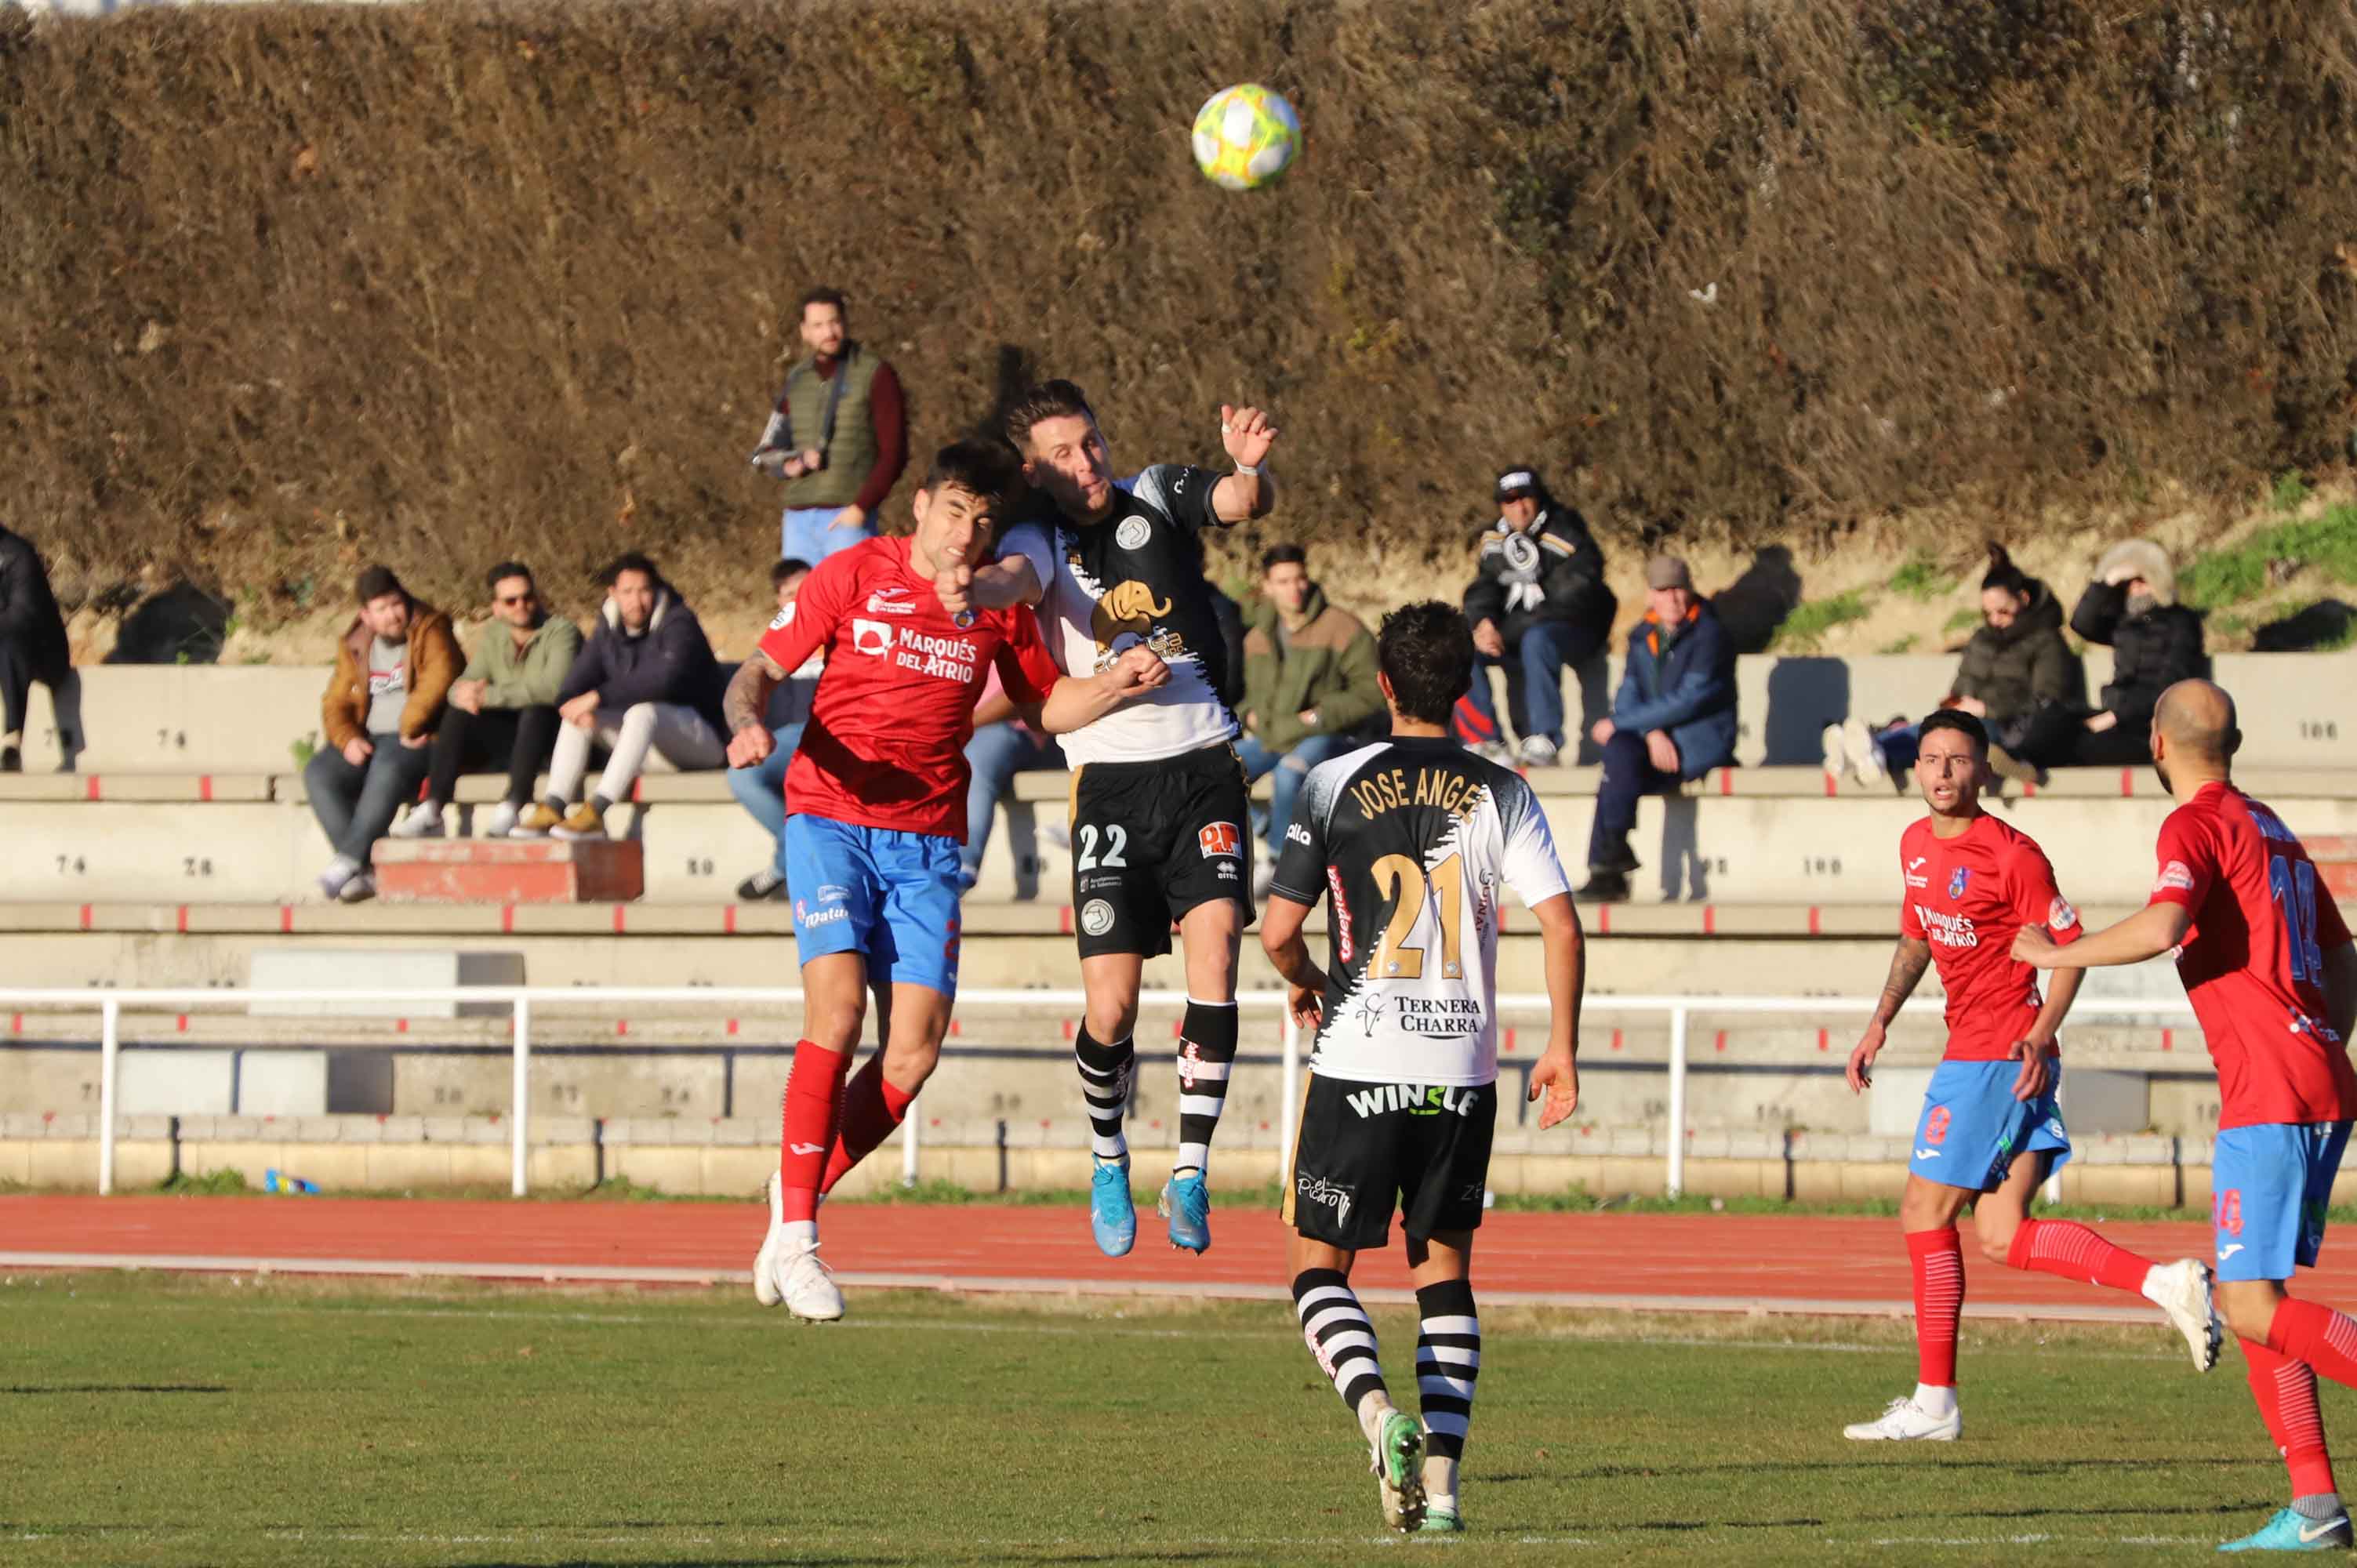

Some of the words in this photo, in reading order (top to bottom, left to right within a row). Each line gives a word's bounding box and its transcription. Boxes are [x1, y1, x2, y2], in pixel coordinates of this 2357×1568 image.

[899, 626, 977, 662] MARQUÉS
[895, 652, 922, 670] DEL
[921, 654, 973, 684] ATRIO
[1349, 769, 1410, 820] JOSE
[1078, 824, 1128, 872] 22
[1367, 853, 1462, 979] 21
[1395, 996, 1481, 1014] TERNERA
[1400, 1014, 1479, 1033] CHARRA
[1925, 1106, 1952, 1145] 8
